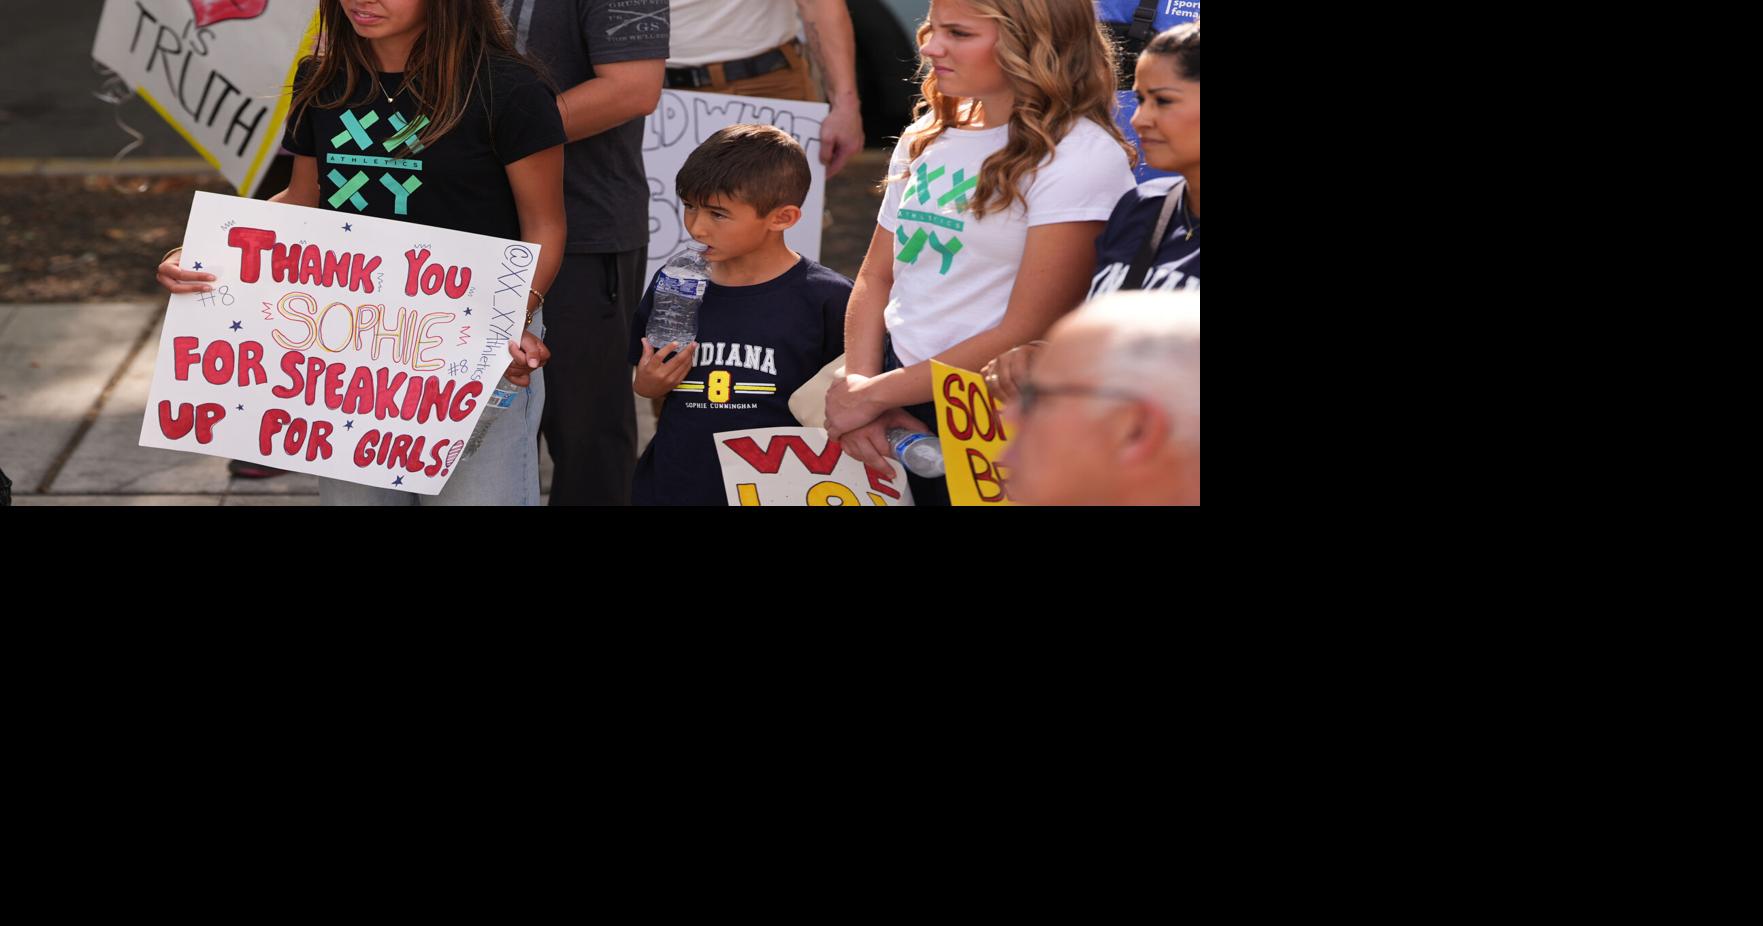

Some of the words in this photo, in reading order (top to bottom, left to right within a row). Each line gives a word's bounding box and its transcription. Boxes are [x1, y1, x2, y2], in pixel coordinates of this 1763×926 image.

[130, 1, 268, 157] TRUTH
[330, 155, 418, 168] ATHLETICS
[195, 285, 235, 308] #8
[227, 227, 382, 294] THANK
[404, 248, 472, 300] YOU
[271, 291, 456, 372] SOPHIE
[448, 359, 469, 377] #8
[173, 336, 268, 387] FOR
[271, 350, 484, 424] SPEAKING
[708, 370, 730, 403] 8
[158, 399, 226, 445] UP
[259, 408, 334, 462] FOR
[353, 429, 465, 477] GIRLS!
